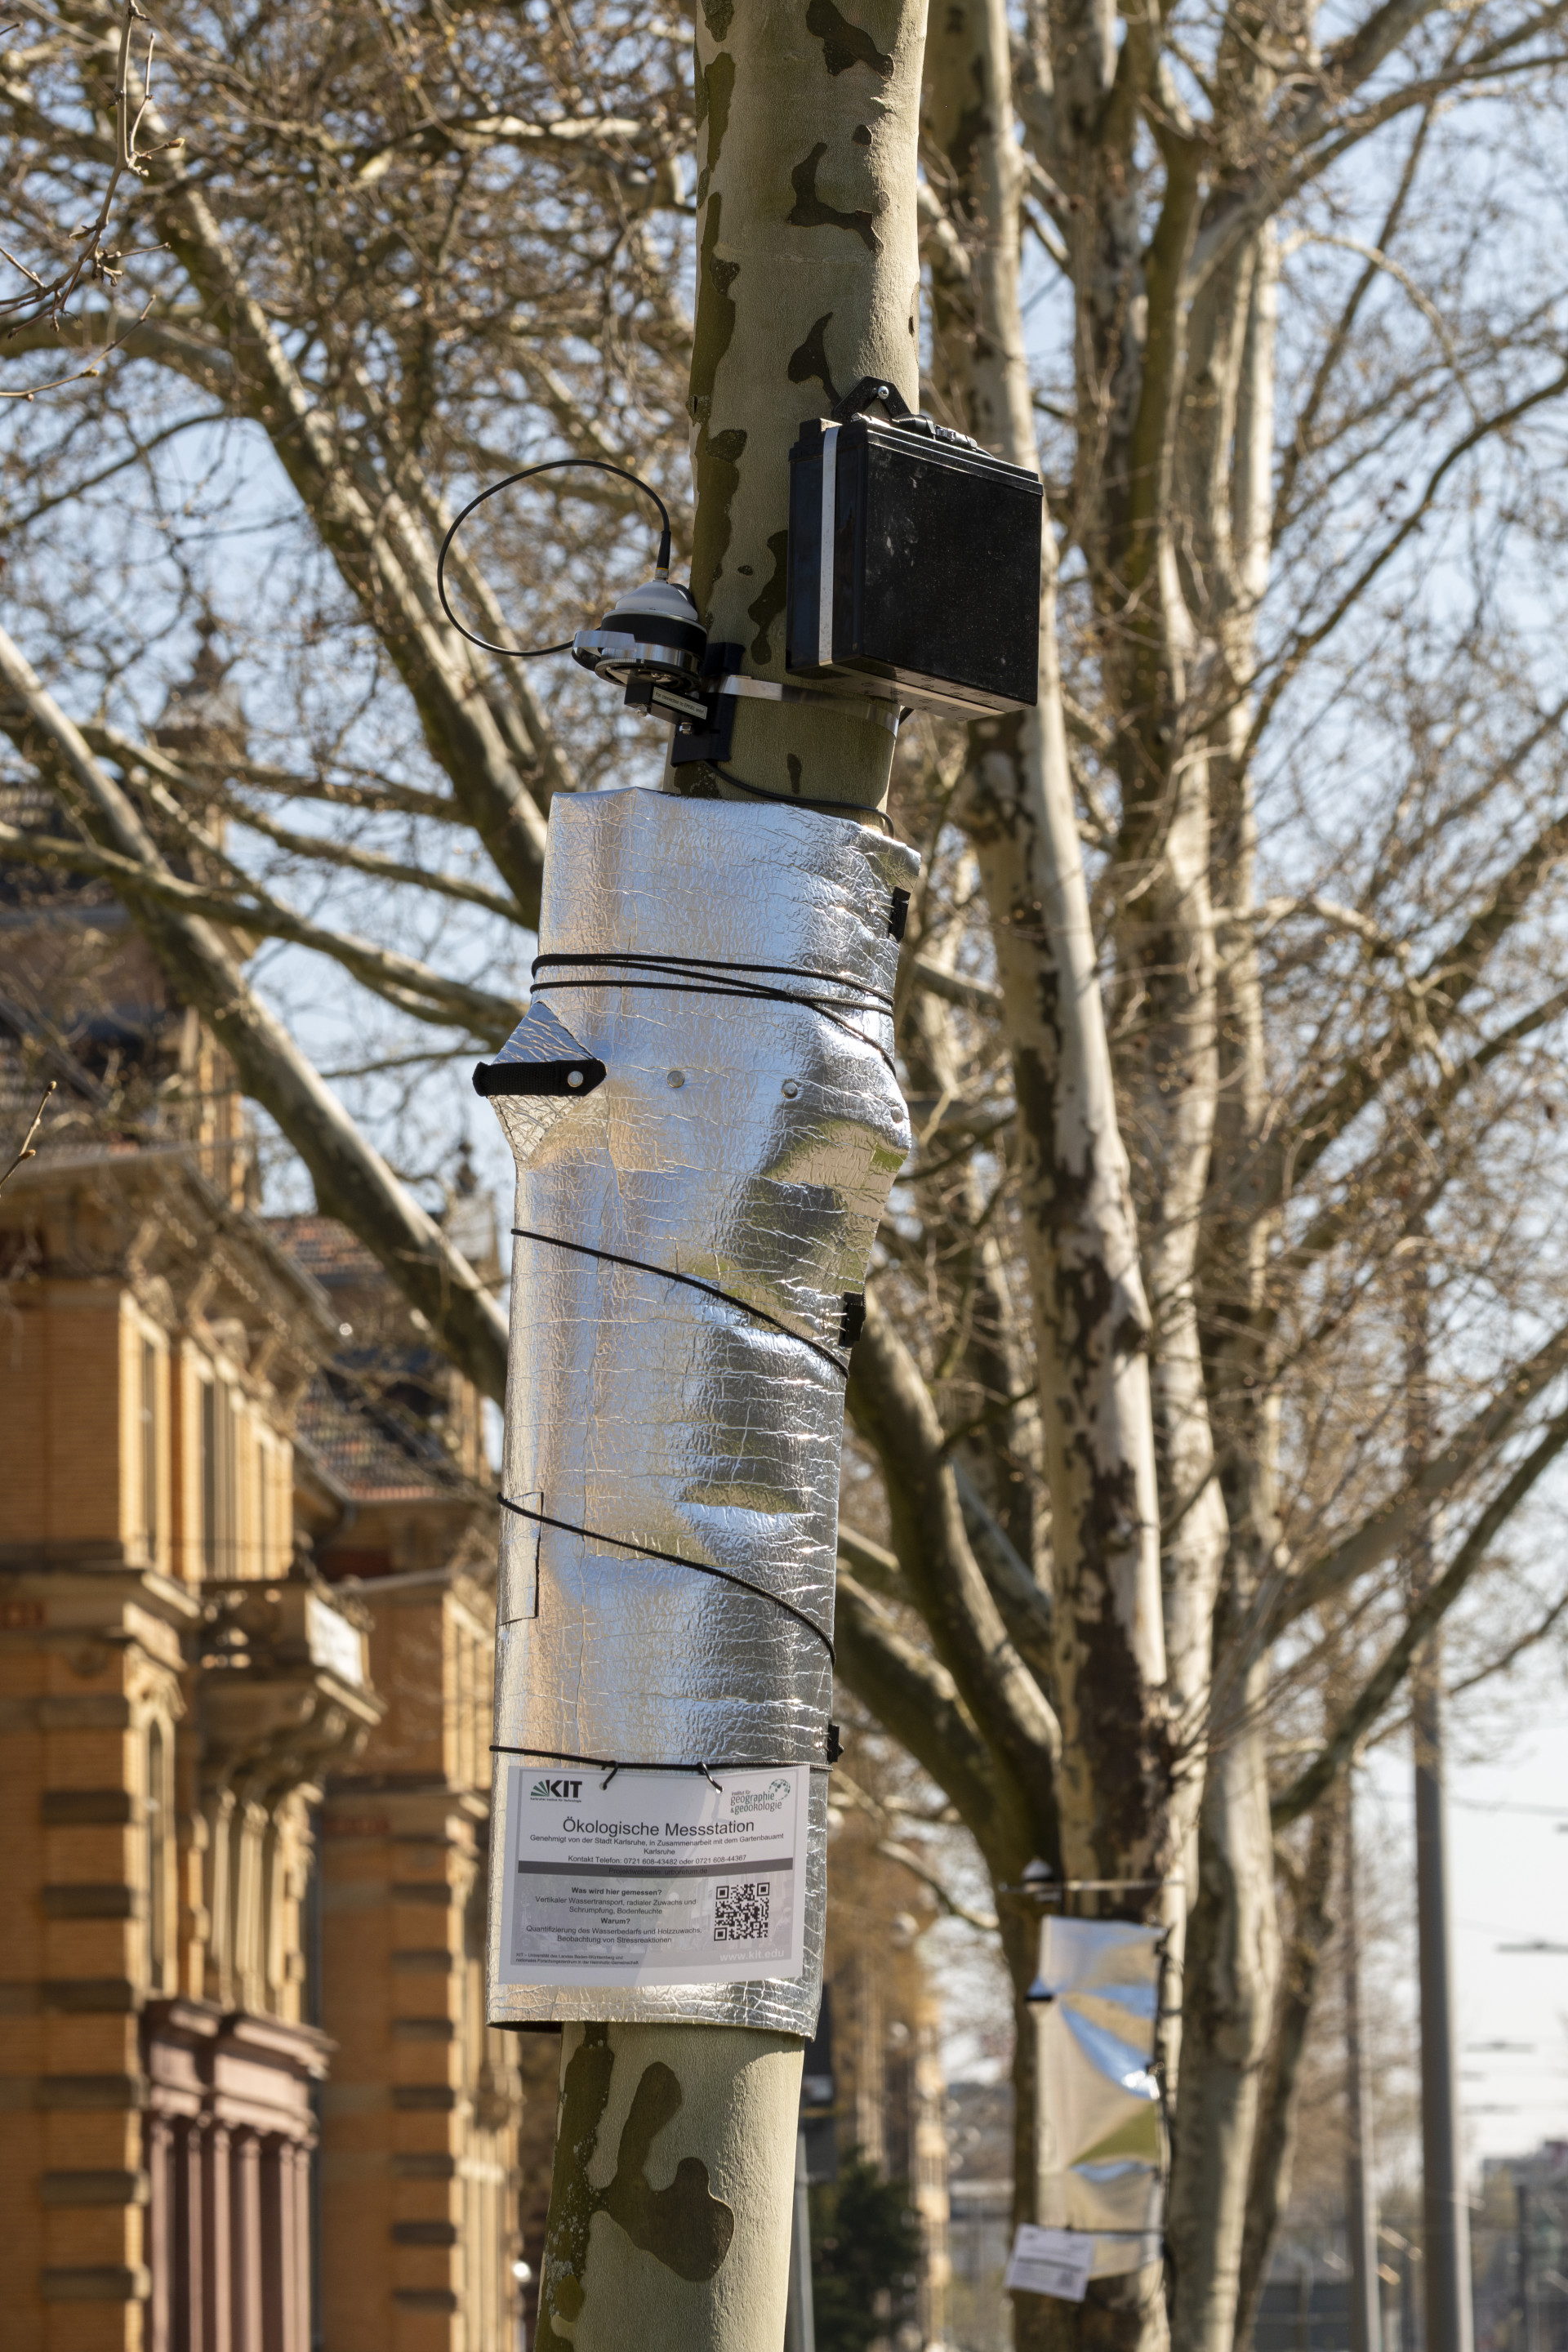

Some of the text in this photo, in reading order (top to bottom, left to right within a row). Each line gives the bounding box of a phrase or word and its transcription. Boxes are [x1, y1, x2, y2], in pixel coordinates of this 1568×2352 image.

[546, 1780, 582, 1798] KIT
[730, 1791, 774, 1806] geographie
[563, 1816, 754, 1838] Ökologische Messstation
[530, 1834, 567, 1843] Genehmigt
[613, 1838, 648, 1846] Karlsruhe,
[739, 1833, 784, 1843] Gartenbauamt
[621, 1889, 662, 1897] gemessen?
[568, 1897, 625, 1906] Wassertransport,
[569, 1906, 615, 1915] Schrumpfung,
[526, 1925, 577, 1935] Quantifizierung
[557, 1936, 601, 1944] Beobachtung
[719, 1949, 785, 1962] www.kit.edu
